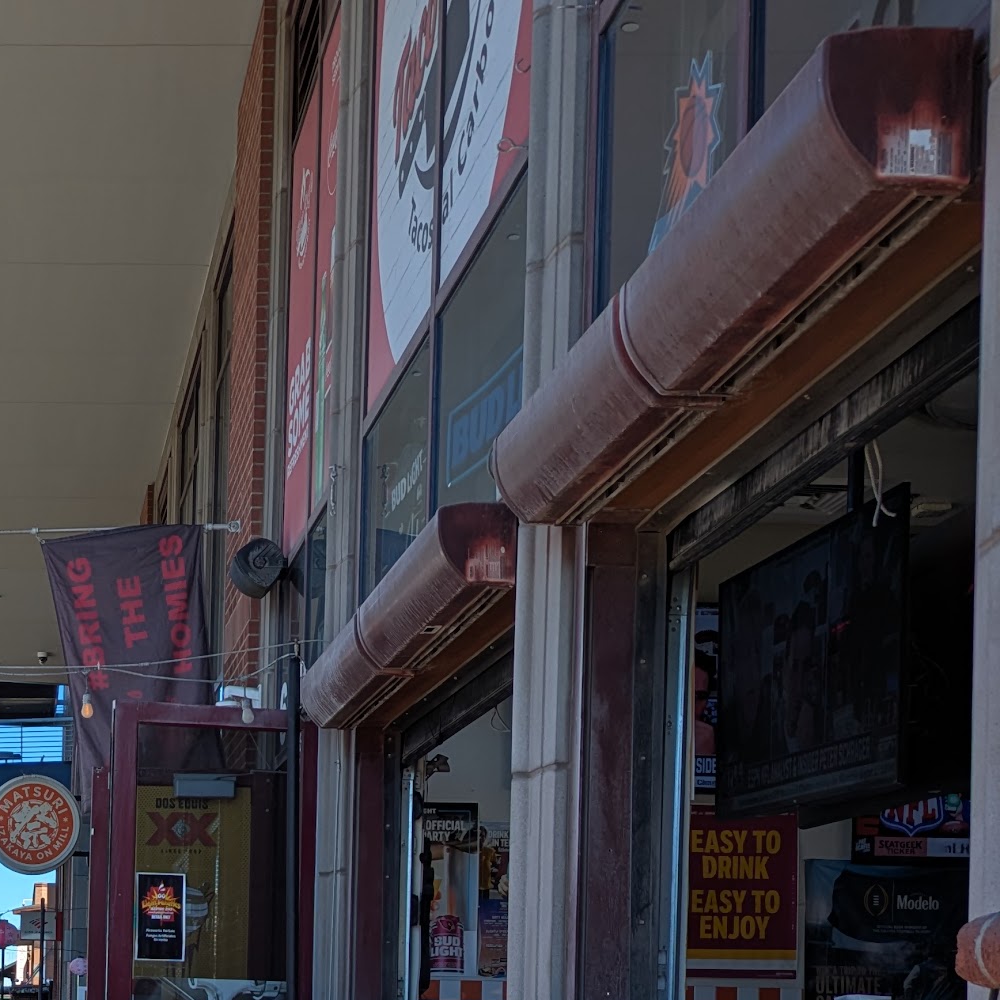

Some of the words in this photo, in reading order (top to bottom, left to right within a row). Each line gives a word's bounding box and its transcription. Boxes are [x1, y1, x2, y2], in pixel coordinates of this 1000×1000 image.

[443, 168, 454, 225] al
[290, 336, 311, 415] GRAB
[288, 380, 310, 458] SOME
[391, 475, 406, 512] BUD
[407, 449, 424, 494] LIGHT
[116, 576, 148, 649] THE
[159, 534, 193, 674] HOMIES
[67, 557, 109, 691] #BRING
[0, 786, 68, 814] MATSURI
[156, 798, 175, 809] DOS
[425, 820, 465, 831] OFFICIAL
[36, 849, 53, 860] ON
[53, 826, 69, 850] MILL
[691, 830, 748, 854] EASY
[752, 830, 781, 854] TO
[879, 840, 922, 849] SEATGEEK
[702, 856, 769, 879] DRINK
[691, 890, 747, 914] EASY
[751, 890, 780, 914] TO
[897, 895, 939, 911] Modelo
[700, 916, 770, 939] ENJOY
[431, 945, 463, 957] LIGHT
[434, 935, 460, 947] BUD
[815, 975, 881, 994] ULTIMATE
